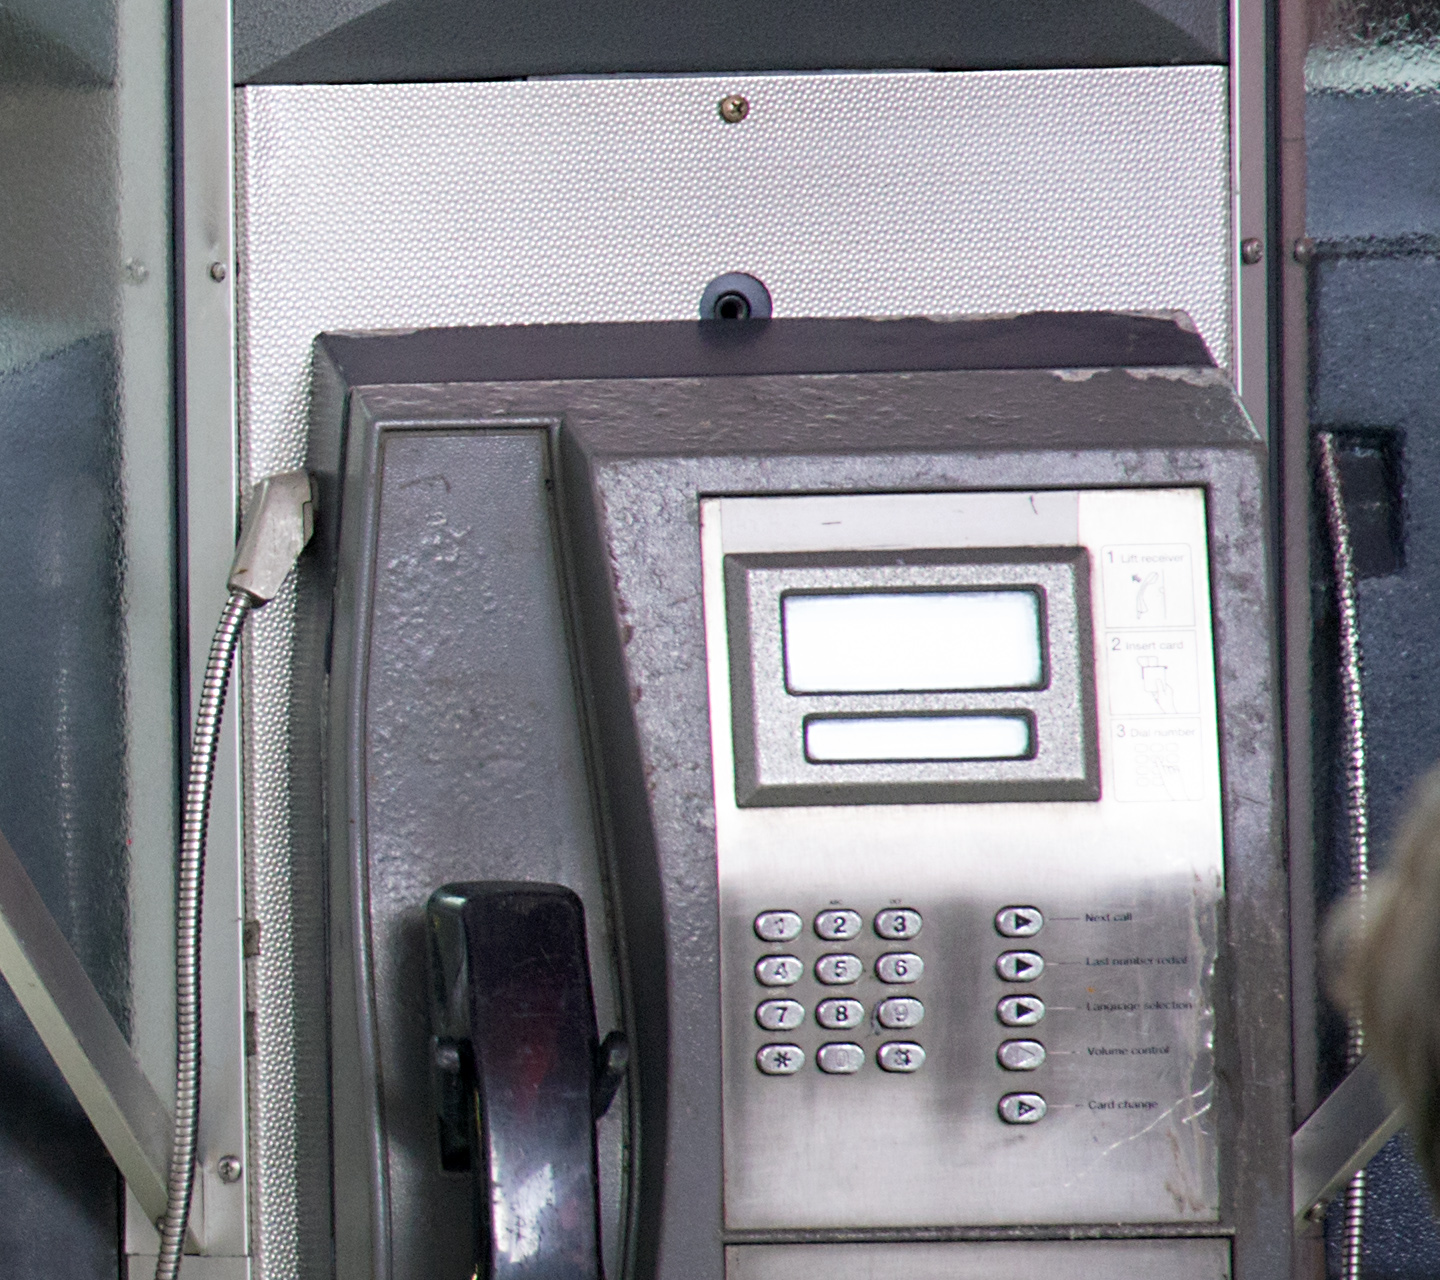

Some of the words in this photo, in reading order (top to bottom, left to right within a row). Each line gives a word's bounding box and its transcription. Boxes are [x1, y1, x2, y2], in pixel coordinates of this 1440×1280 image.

[1108, 551, 1114, 564] 1
[1141, 553, 1184, 564] receiver
[1112, 637, 1122, 652] 2
[1126, 640, 1156, 651] Insert
[1160, 639, 1184, 651] card
[1116, 724, 1126, 738] 3
[1130, 727, 1151, 738] Dial
[1154, 727, 1196, 738] number
[774, 918, 785, 935] 1
[833, 916, 847, 934] 2
[893, 915, 907, 933] 3
[774, 962, 788, 979] 4
[834, 960, 848, 978] 5
[894, 959, 908, 977] 6
[775, 1006, 788, 1023] 7
[835, 1005, 849, 1022] 8
[894, 1003, 909, 1022] 9
[1087, 1046, 1128, 1057] Volume
[1131, 1045, 1170, 1056] control
[1088, 1100, 1115, 1111] Card
[1117, 1099, 1159, 1112] change
